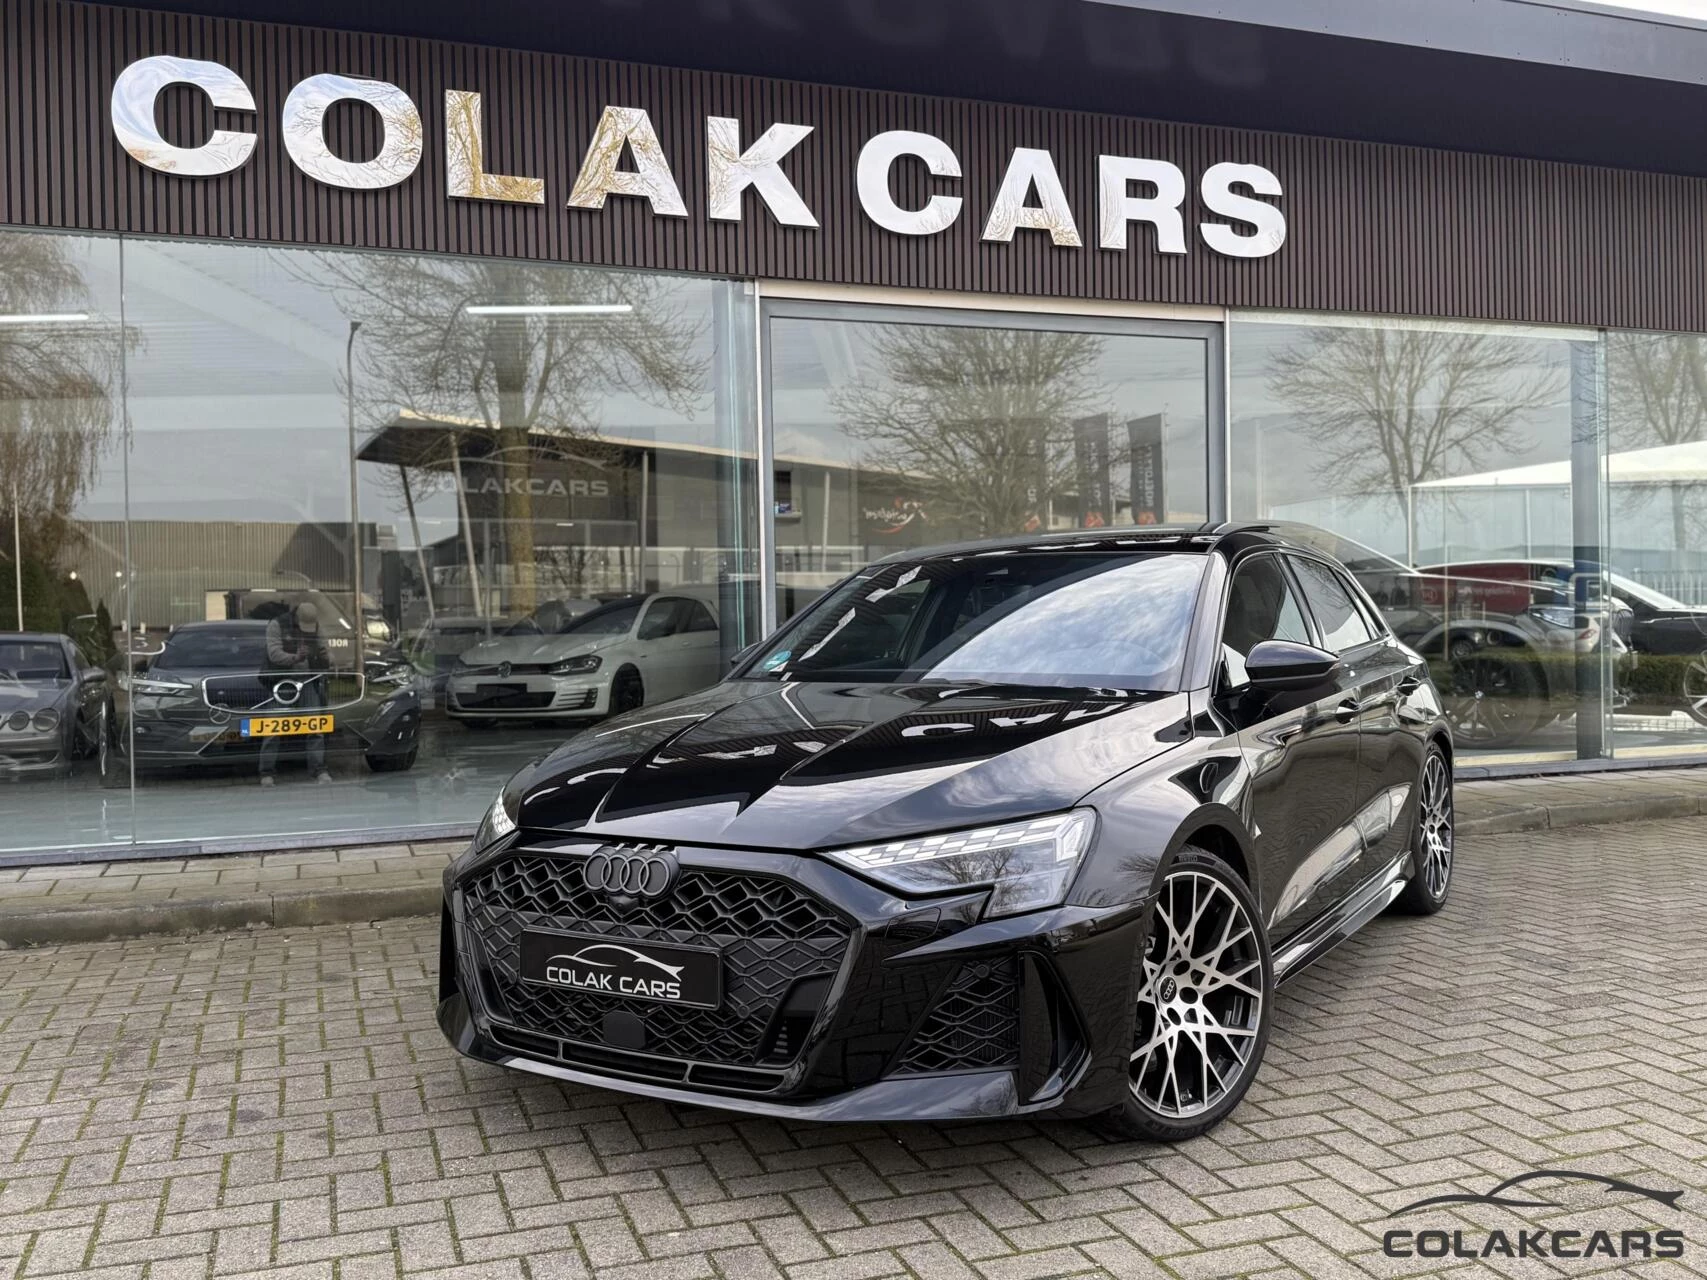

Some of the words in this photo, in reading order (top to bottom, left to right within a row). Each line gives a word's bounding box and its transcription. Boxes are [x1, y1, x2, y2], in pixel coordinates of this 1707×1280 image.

[111, 54, 820, 229] COLAK
[856, 129, 1287, 259] CARS
[255, 717, 329, 734] J-289-GP
[546, 966, 613, 991] COLAK
[619, 976, 681, 999] CARS
